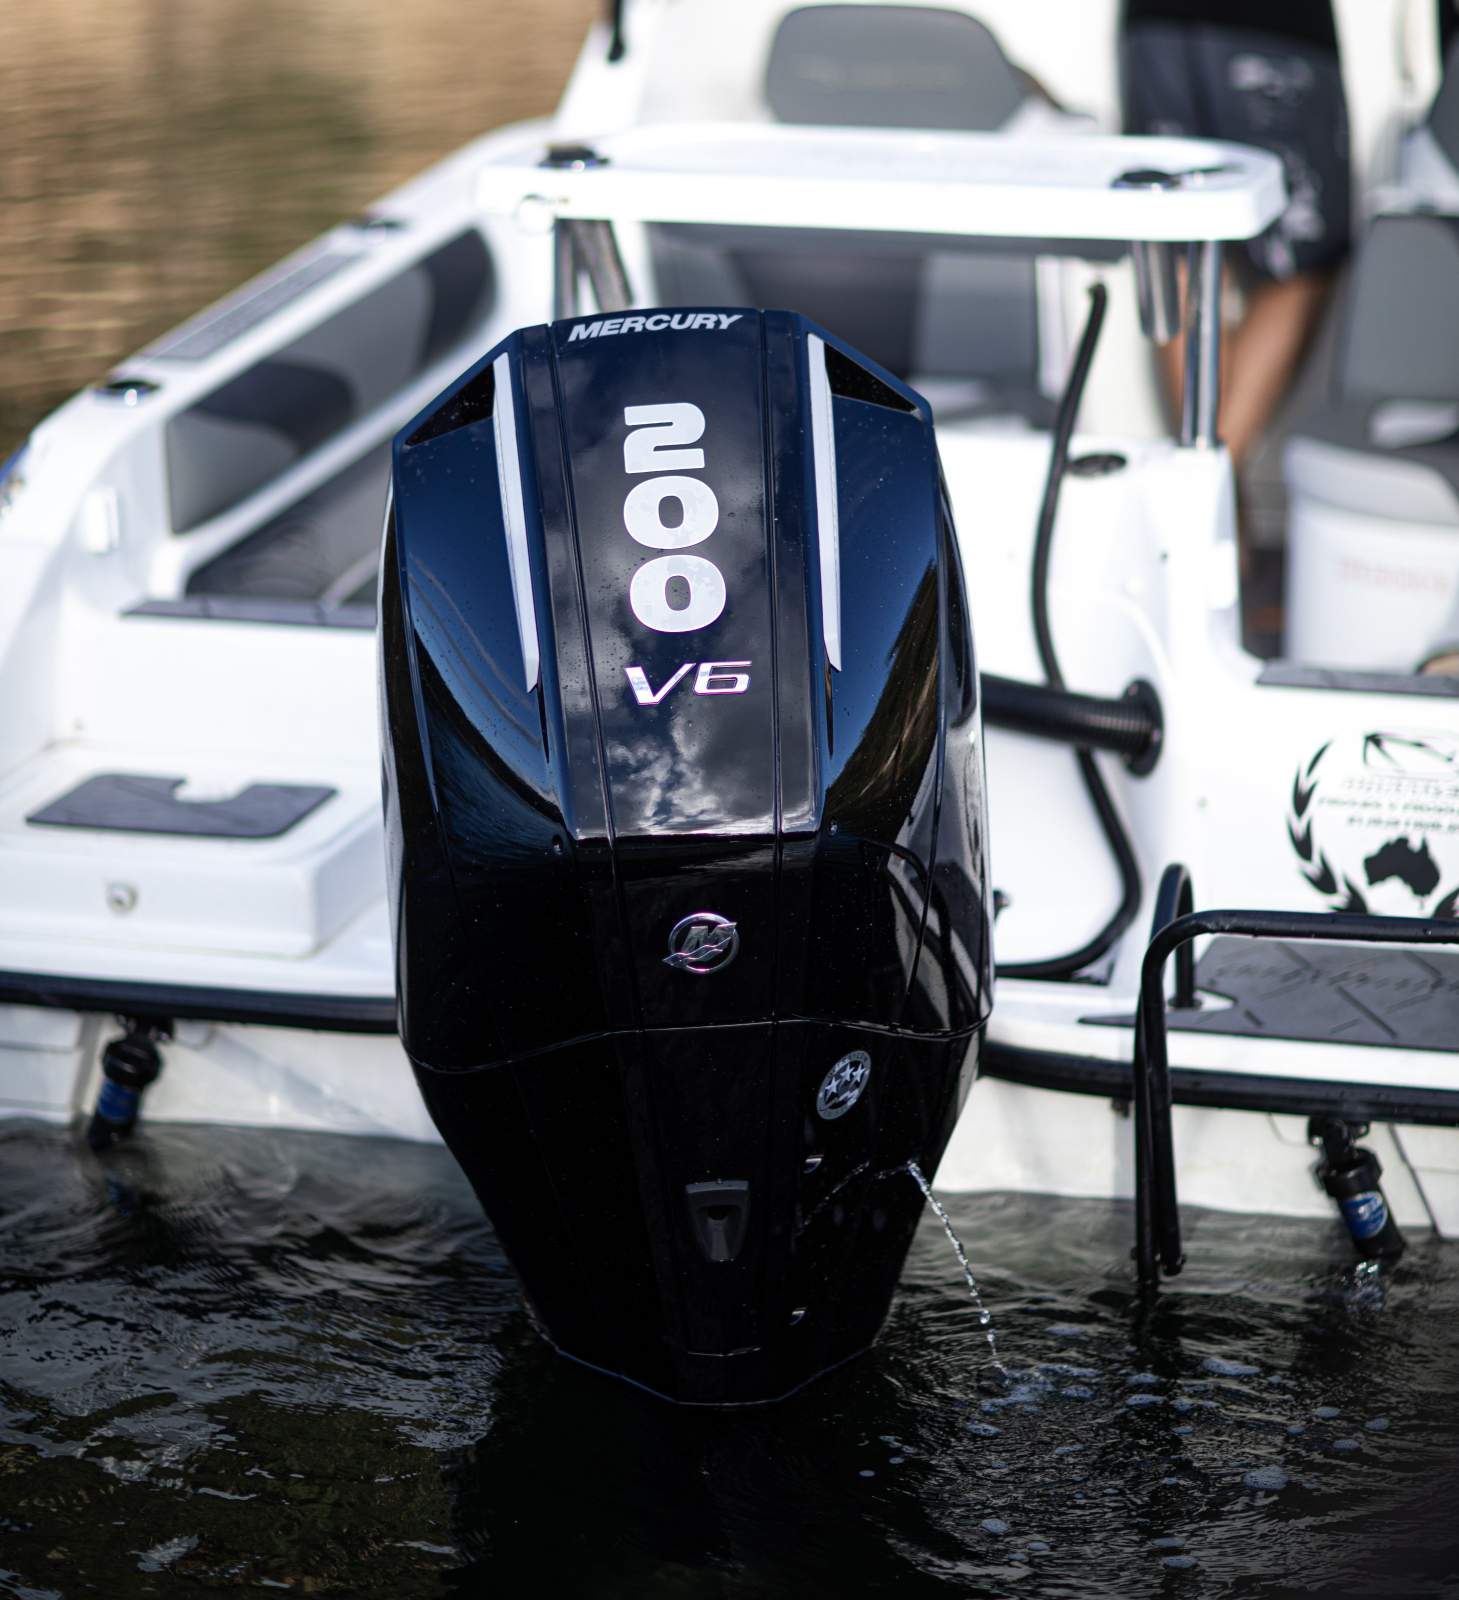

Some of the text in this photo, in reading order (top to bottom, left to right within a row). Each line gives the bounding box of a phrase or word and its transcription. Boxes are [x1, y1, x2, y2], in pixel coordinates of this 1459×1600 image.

[567, 313, 743, 342] MERCURY
[623, 402, 726, 632] 200
[624, 660, 752, 706] V6
